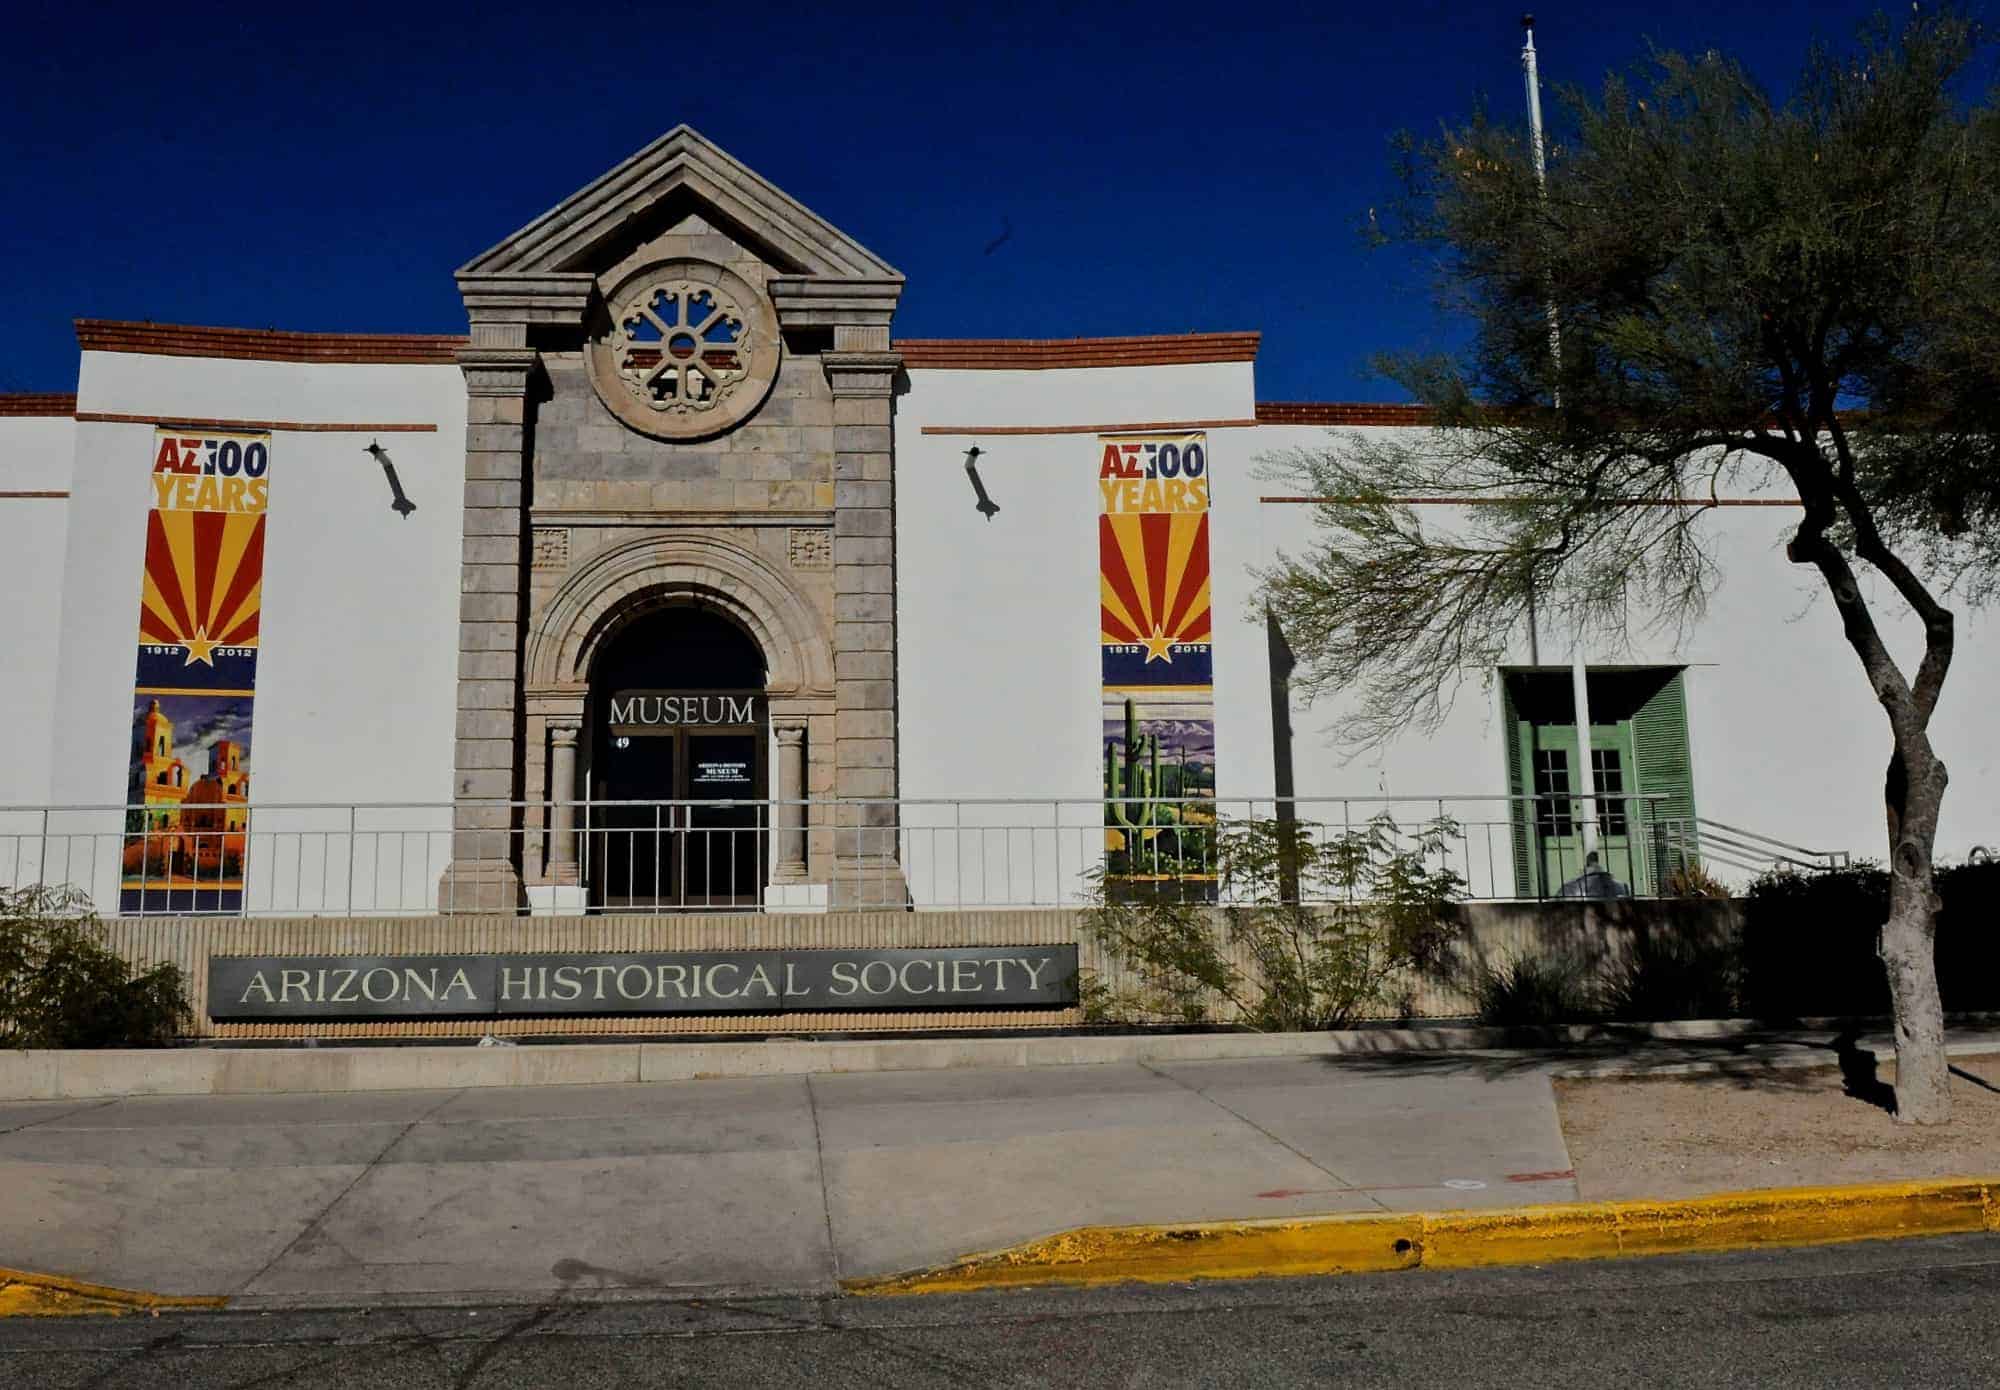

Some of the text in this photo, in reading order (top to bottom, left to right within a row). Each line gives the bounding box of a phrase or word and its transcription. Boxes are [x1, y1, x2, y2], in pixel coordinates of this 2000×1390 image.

[154, 475, 267, 512] YEARS
[1100, 478, 1208, 512] YEARS
[146, 647, 179, 656] 1912
[217, 648, 252, 657] 2012
[1109, 645, 1140, 654] 1912
[1174, 644, 1208, 653] 2012
[608, 696, 755, 724] MUSEUM
[616, 737, 630, 748] 49
[240, 958, 1050, 1003] ARIZONA HISTORICAL SOCIETY
